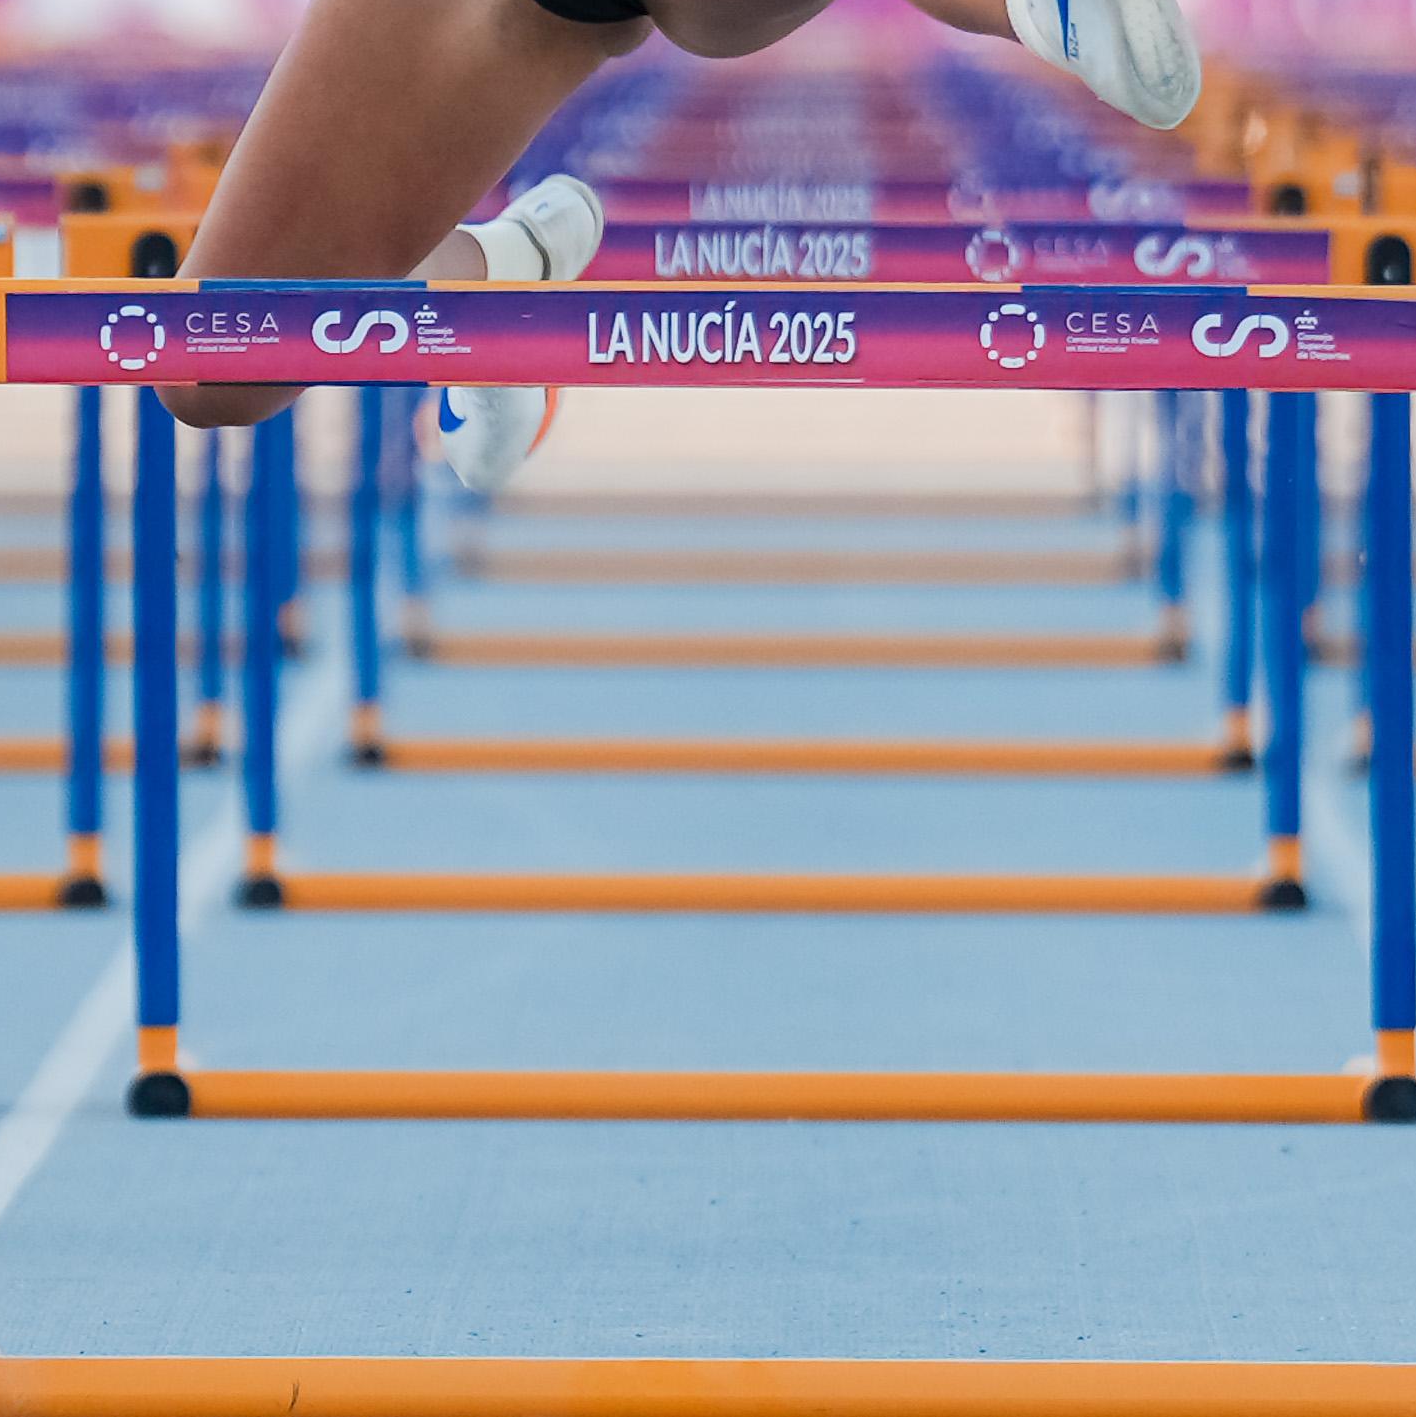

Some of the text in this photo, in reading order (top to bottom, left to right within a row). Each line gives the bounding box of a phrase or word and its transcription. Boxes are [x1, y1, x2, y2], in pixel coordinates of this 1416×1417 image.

[655, 224, 868, 276] LA NUCÍA 2025
[185, 312, 280, 333] CESA
[588, 301, 856, 363] LA NUCÍA 2025
[1065, 312, 1160, 334] CESA
